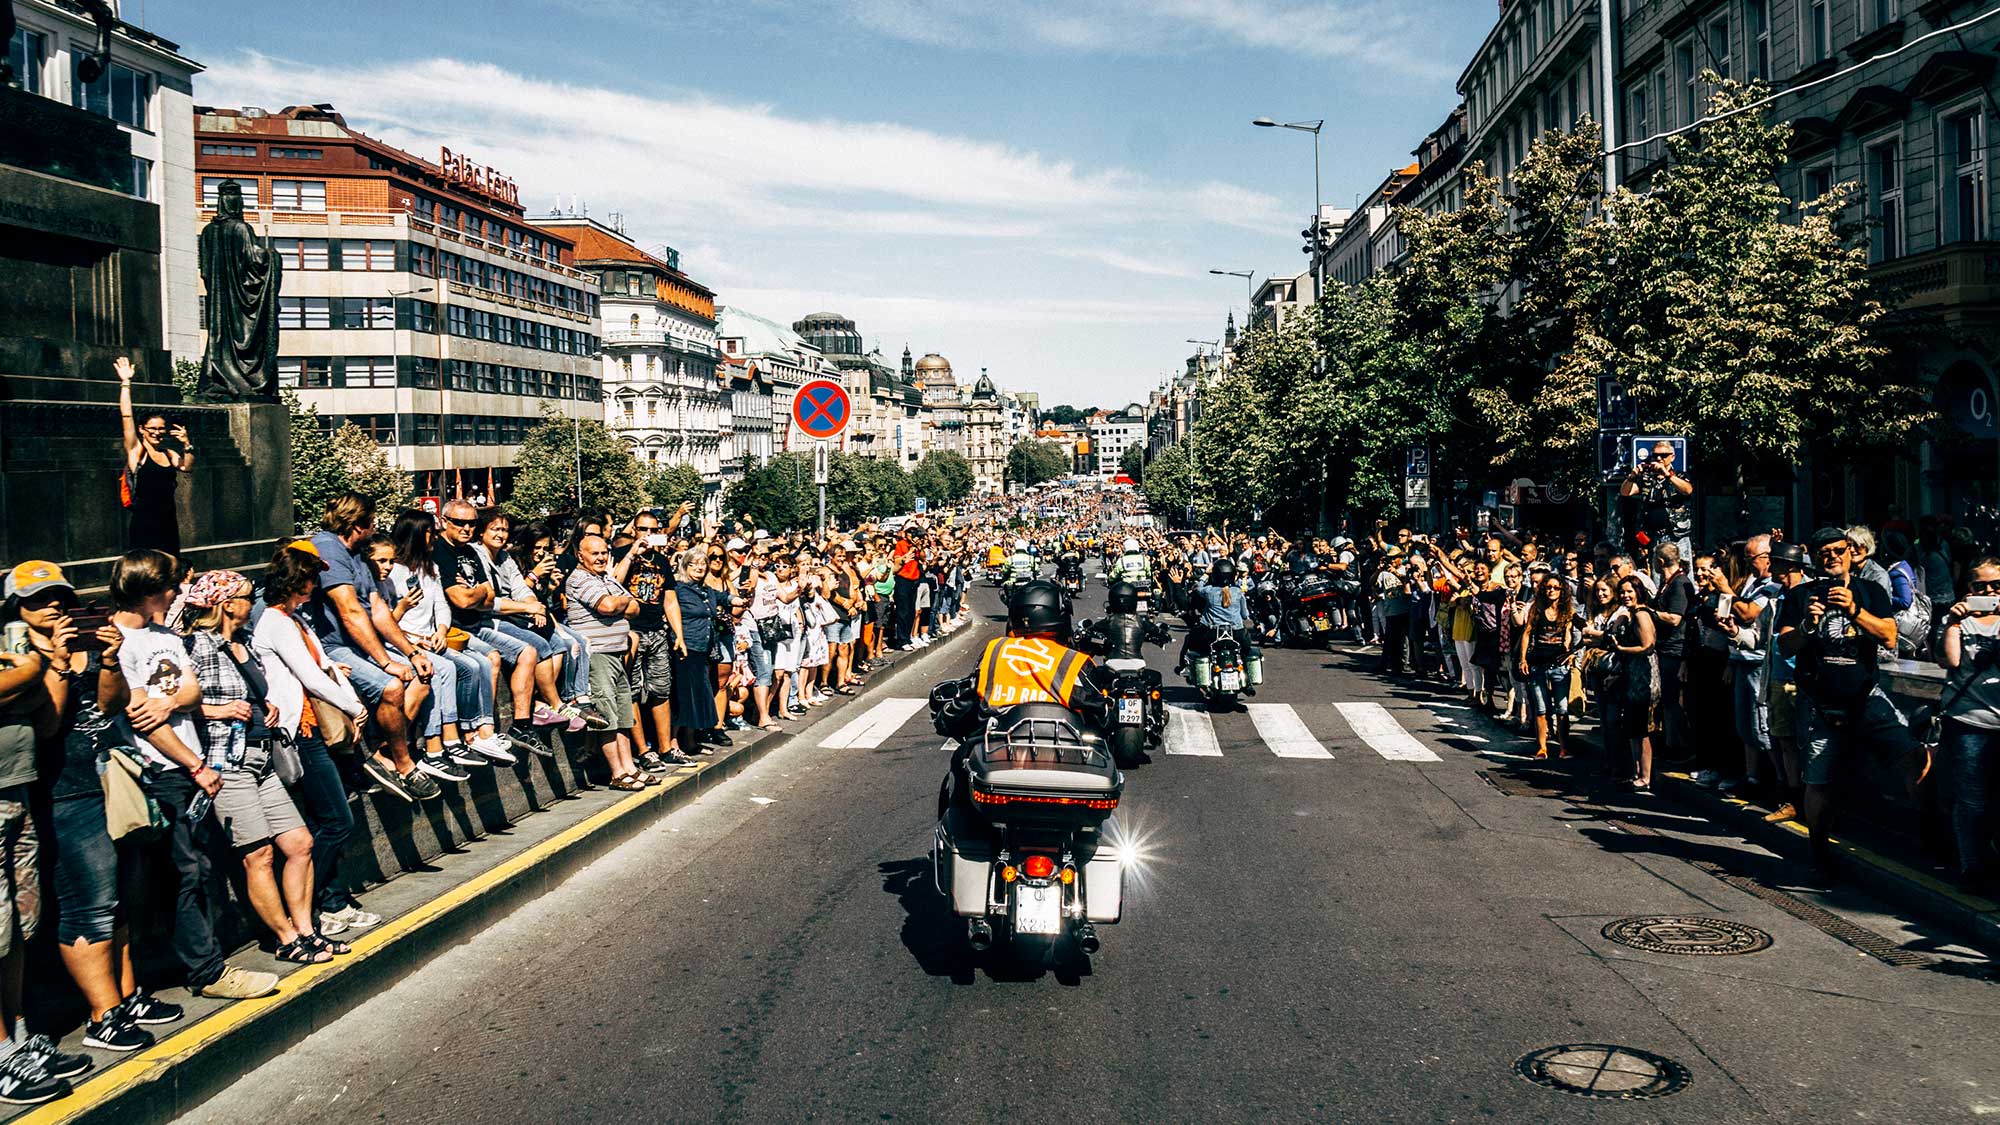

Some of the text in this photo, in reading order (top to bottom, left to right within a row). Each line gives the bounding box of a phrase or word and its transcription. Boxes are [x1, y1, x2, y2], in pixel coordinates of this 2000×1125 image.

[1970, 387, 1993, 427] O2
[1412, 448, 1425, 467] P
[917, 500, 924, 510] P
[993, 683, 1016, 702] H-D
